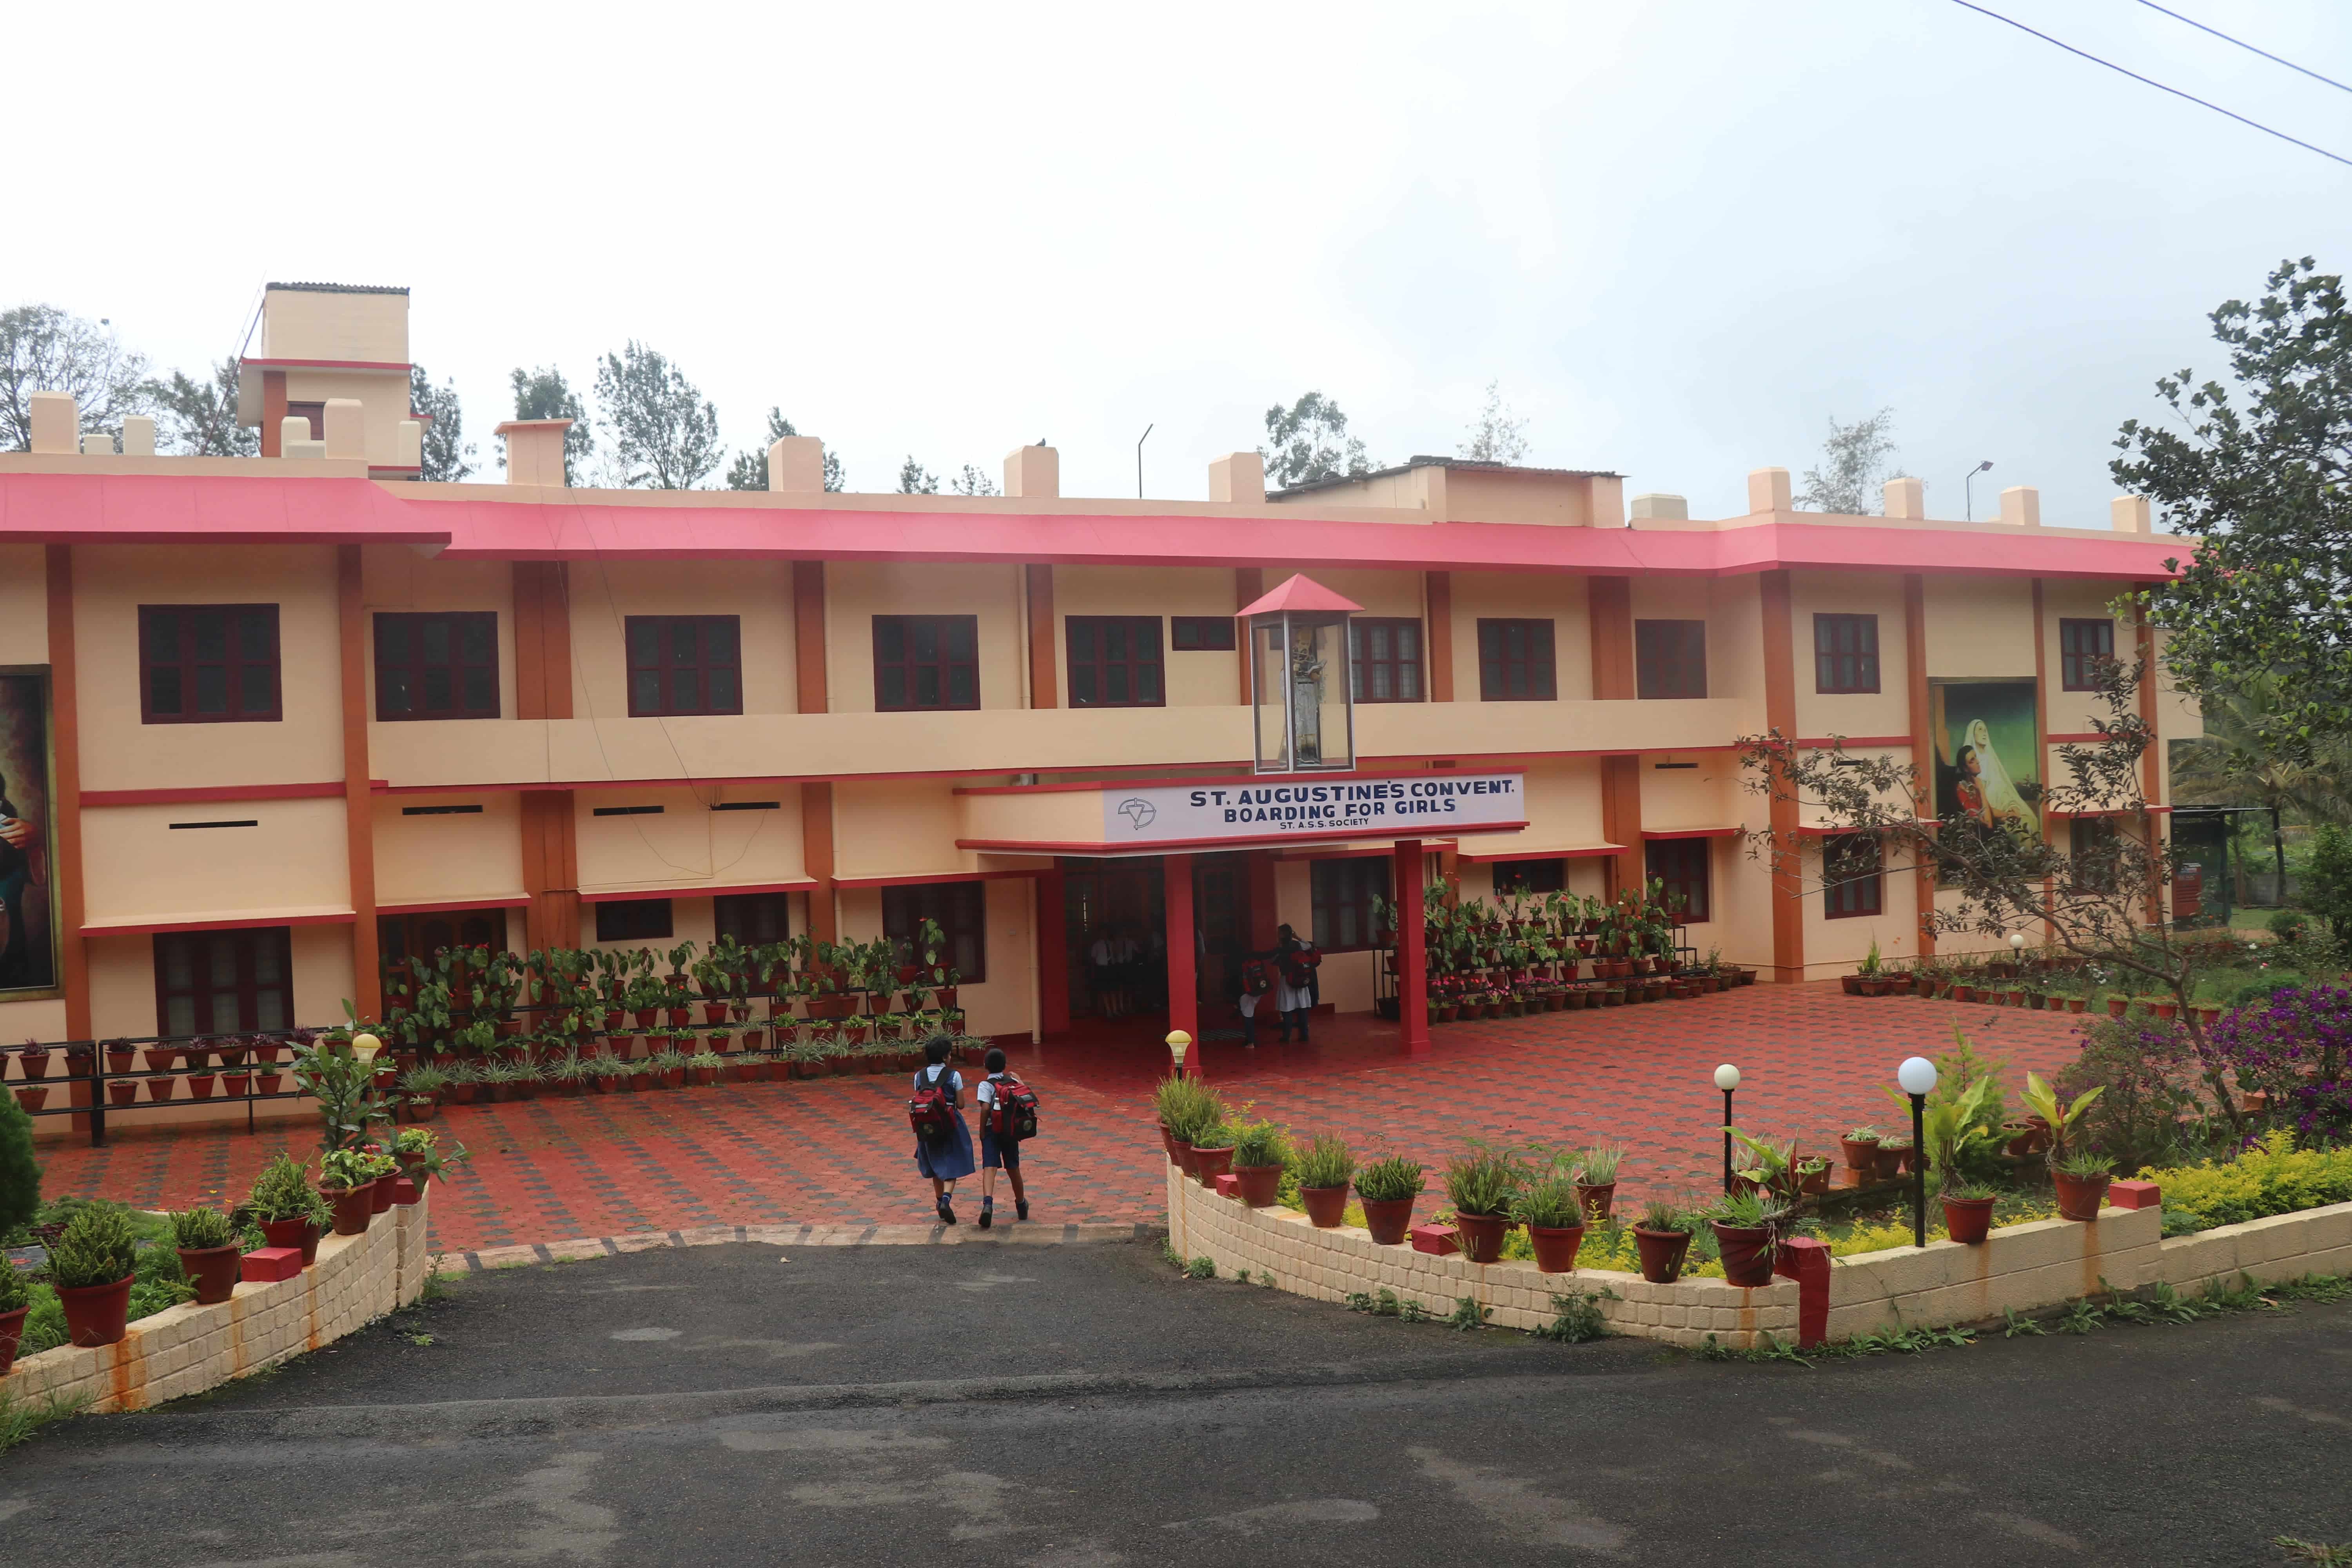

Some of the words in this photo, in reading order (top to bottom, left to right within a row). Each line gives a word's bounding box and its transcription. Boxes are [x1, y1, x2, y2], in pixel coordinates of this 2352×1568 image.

[1190, 791, 1230, 807] ST.
[1410, 779, 1514, 797] CONVENT.
[1224, 805, 1336, 823] BOARDING
[1345, 802, 1385, 817] FOR
[1394, 798, 1456, 815] GIRLS
[1279, 822, 1295, 830] ST.
[1298, 820, 1327, 829] A.S.S.
[1328, 818, 1369, 827] SOCIETY
